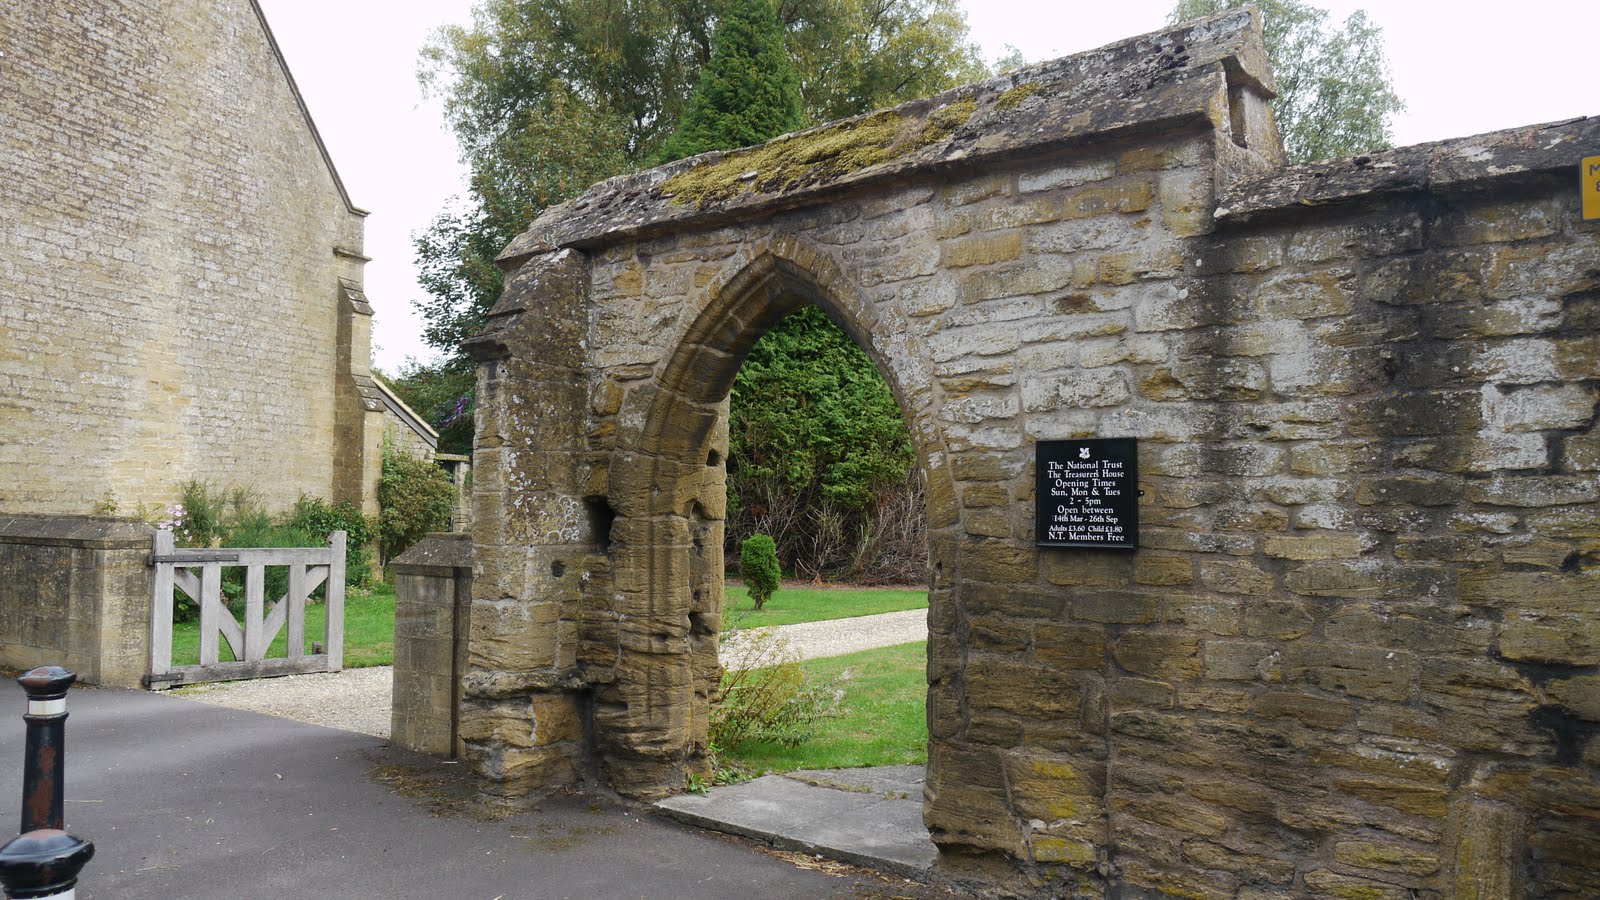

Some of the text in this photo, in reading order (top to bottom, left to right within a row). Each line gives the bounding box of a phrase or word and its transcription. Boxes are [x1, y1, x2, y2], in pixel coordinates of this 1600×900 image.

[1102, 460, 1122, 468] Trust
[1056, 478, 1115, 488] Opening Times
[1051, 488, 1068, 496] Sun,
[1092, 487, 1100, 496] &
[1104, 487, 1120, 495] Tues
[1085, 497, 1101, 506] 5pm
[1058, 505, 1078, 515] Open
[1106, 515, 1118, 524] Sep
[1069, 532, 1103, 540] Members
[1107, 533, 1124, 541] Free
